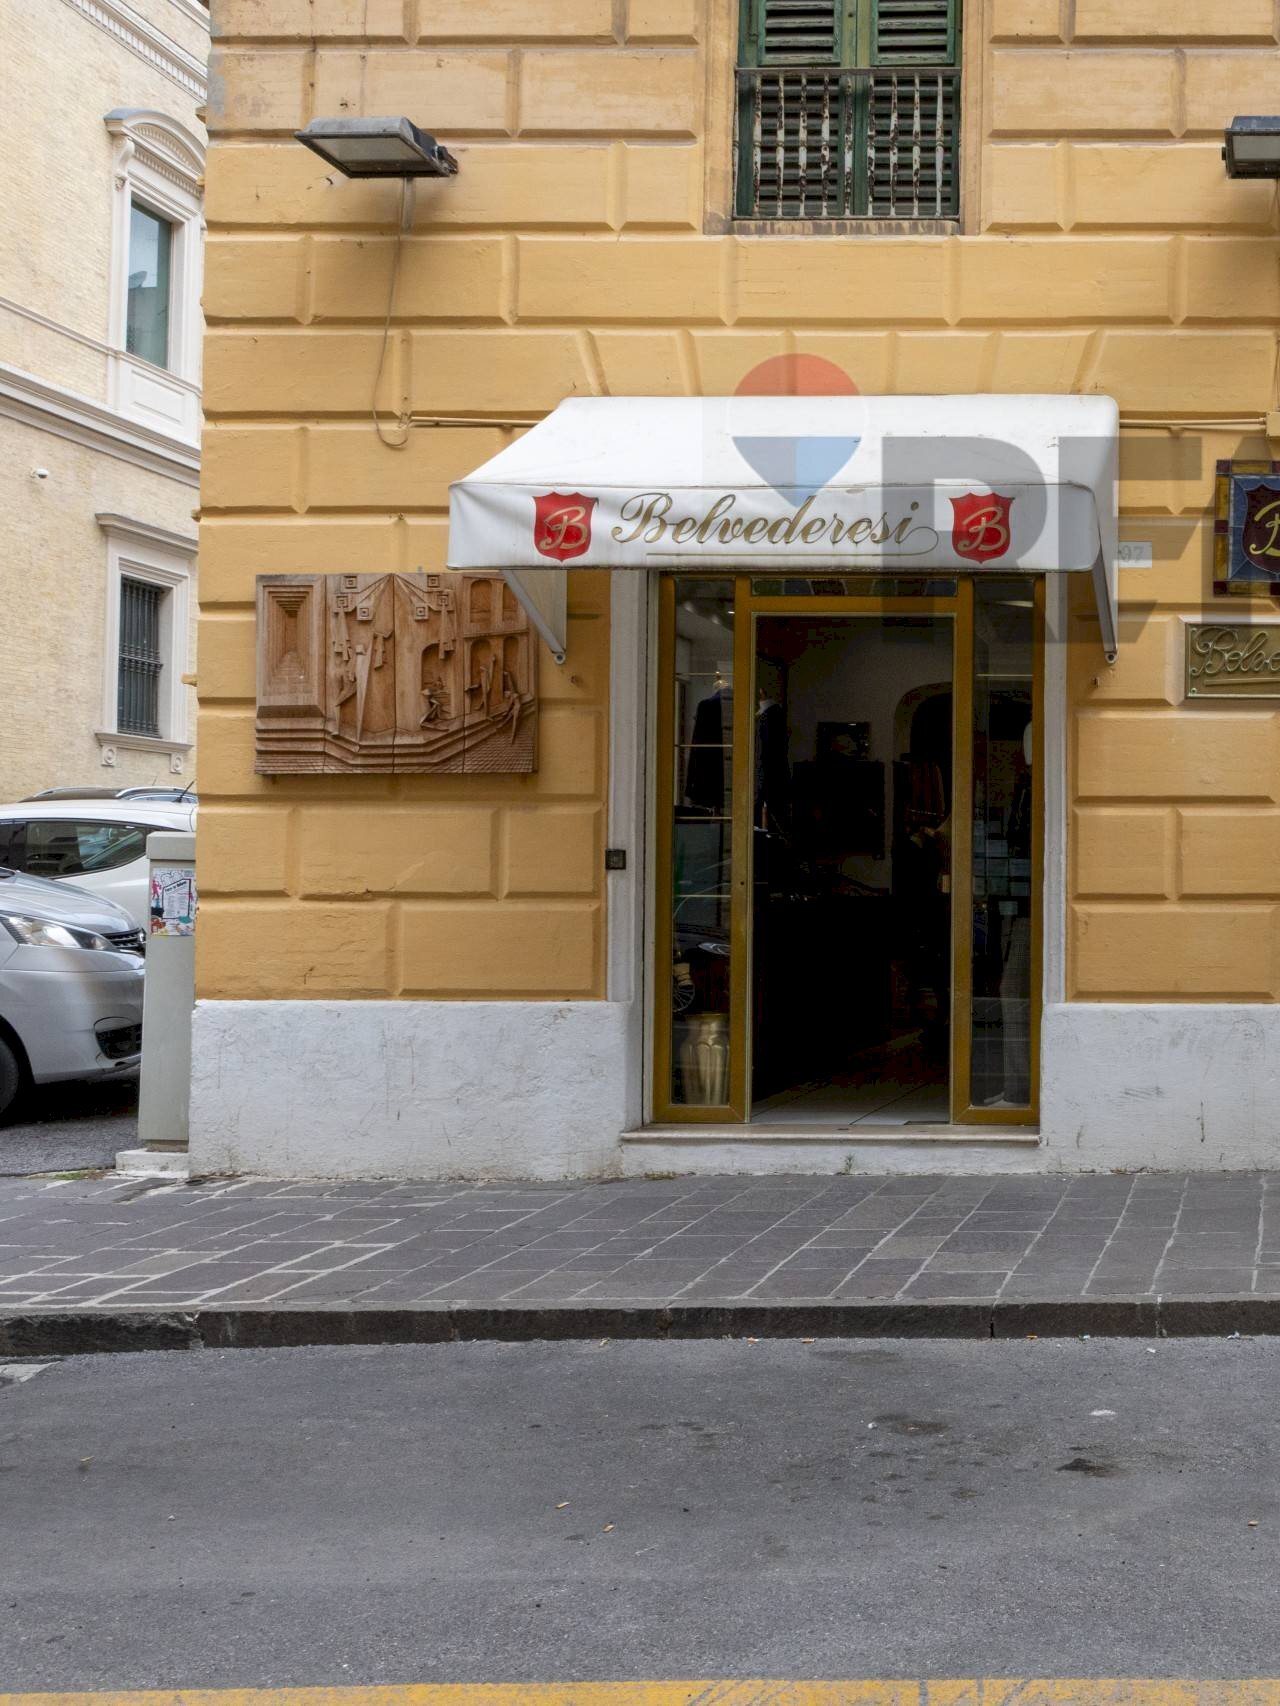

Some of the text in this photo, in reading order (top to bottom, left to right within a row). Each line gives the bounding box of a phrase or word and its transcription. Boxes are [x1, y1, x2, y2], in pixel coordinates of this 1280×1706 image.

[543, 507, 588, 551] B
[612, 492, 932, 548] Belvederesi
[961, 507, 1009, 552] B
